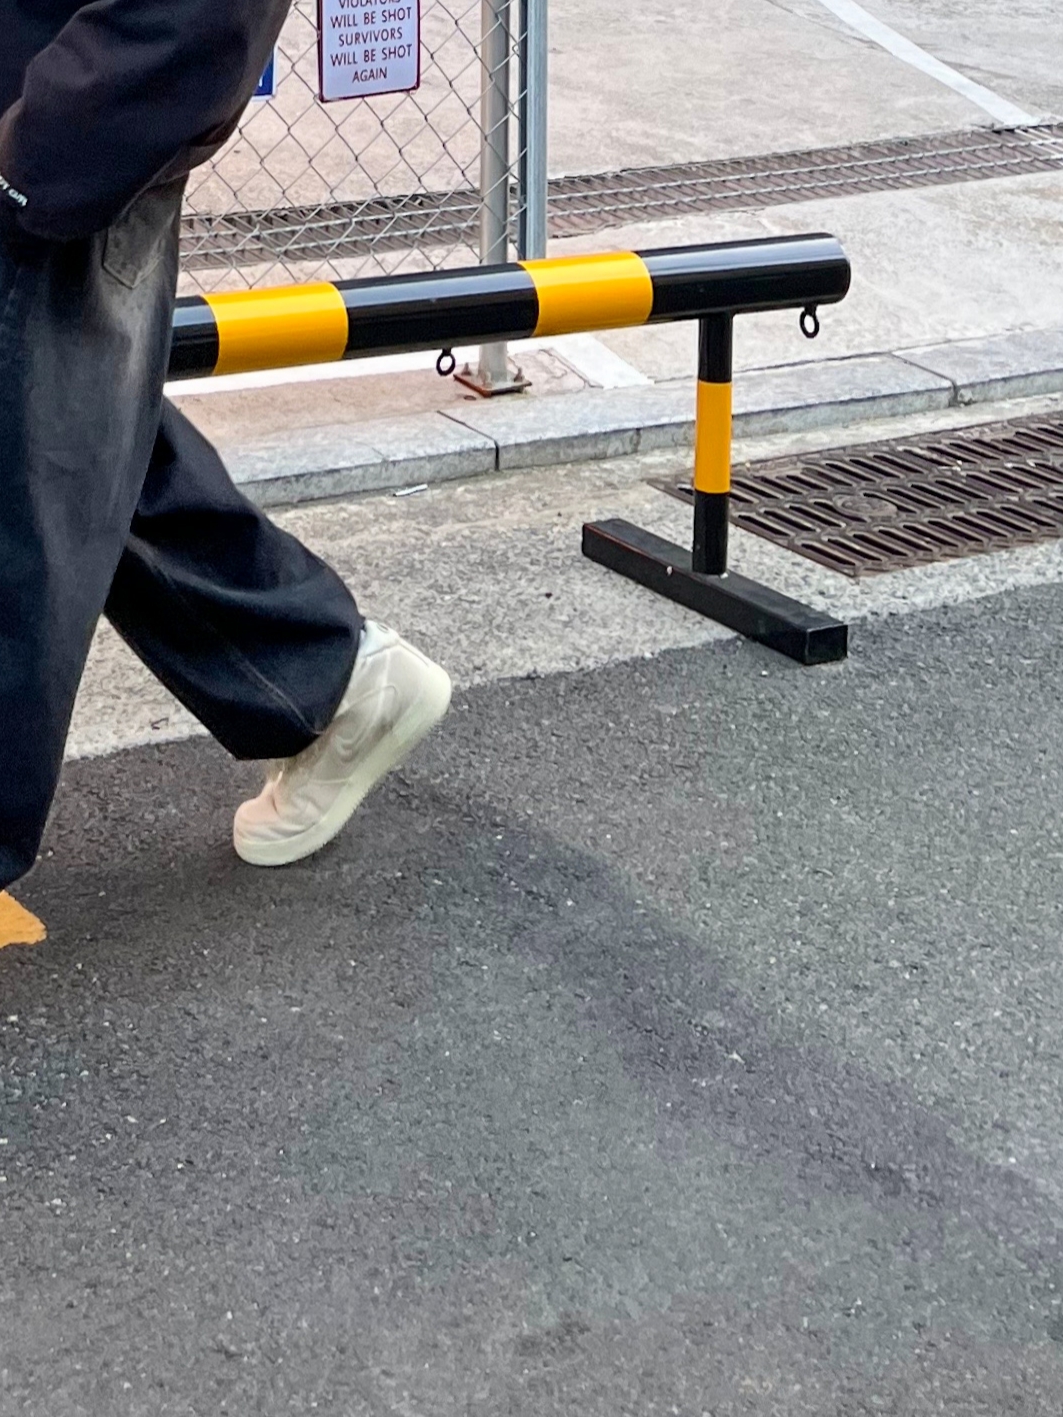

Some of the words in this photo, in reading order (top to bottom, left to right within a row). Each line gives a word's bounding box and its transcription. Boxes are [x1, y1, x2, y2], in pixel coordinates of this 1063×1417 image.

[330, 13, 358, 29] WILL
[363, 10, 376, 25] BE
[381, 6, 412, 23] SHOT
[338, 26, 403, 47] SURVIVORS
[330, 51, 358, 67] WILL
[363, 48, 376, 63] BE
[381, 43, 413, 61] SHOT
[351, 66, 388, 83] AGAIN
